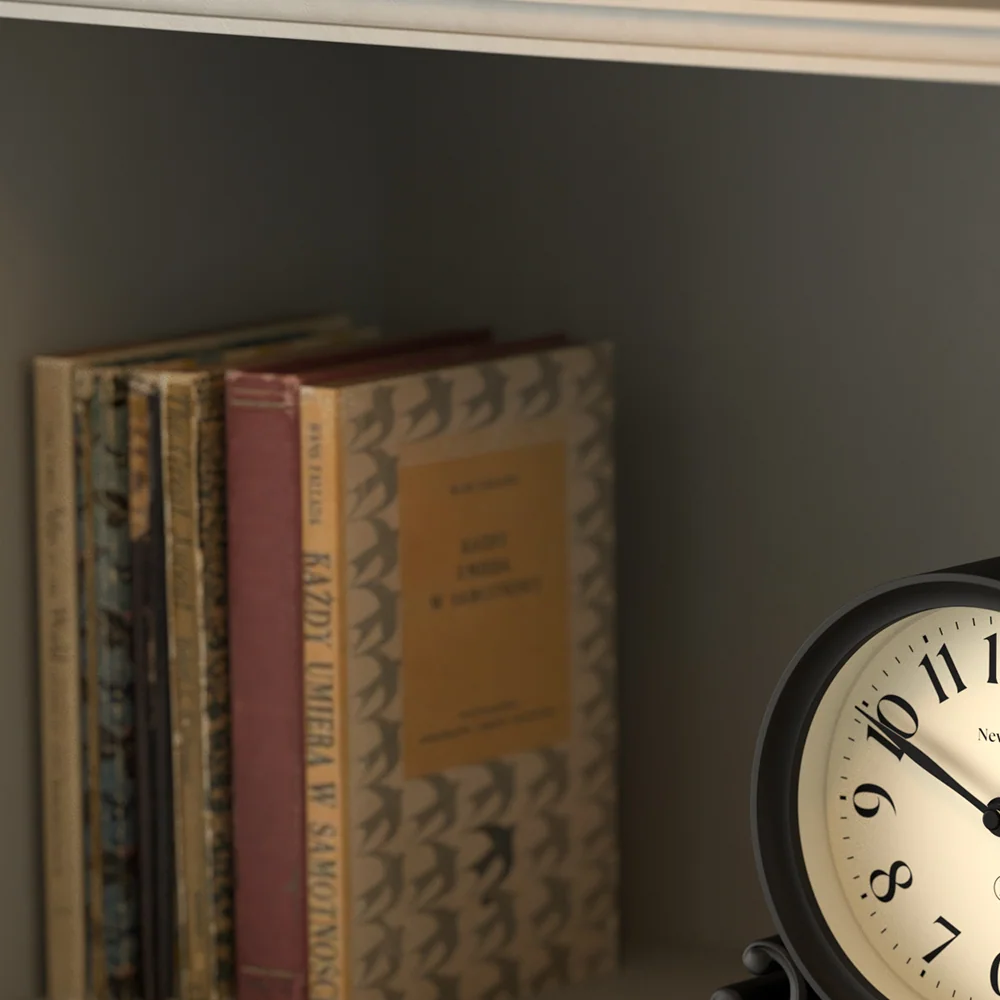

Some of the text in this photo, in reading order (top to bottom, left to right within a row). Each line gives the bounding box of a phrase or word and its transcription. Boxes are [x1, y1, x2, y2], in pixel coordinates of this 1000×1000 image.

[918, 643, 967, 703] 11
[305, 660, 335, 768] UMIERA
[866, 694, 919, 761] 10
[308, 782, 337, 809] W
[852, 783, 897, 818] 9
[869, 860, 913, 903] 8
[922, 916, 962, 963] 7
